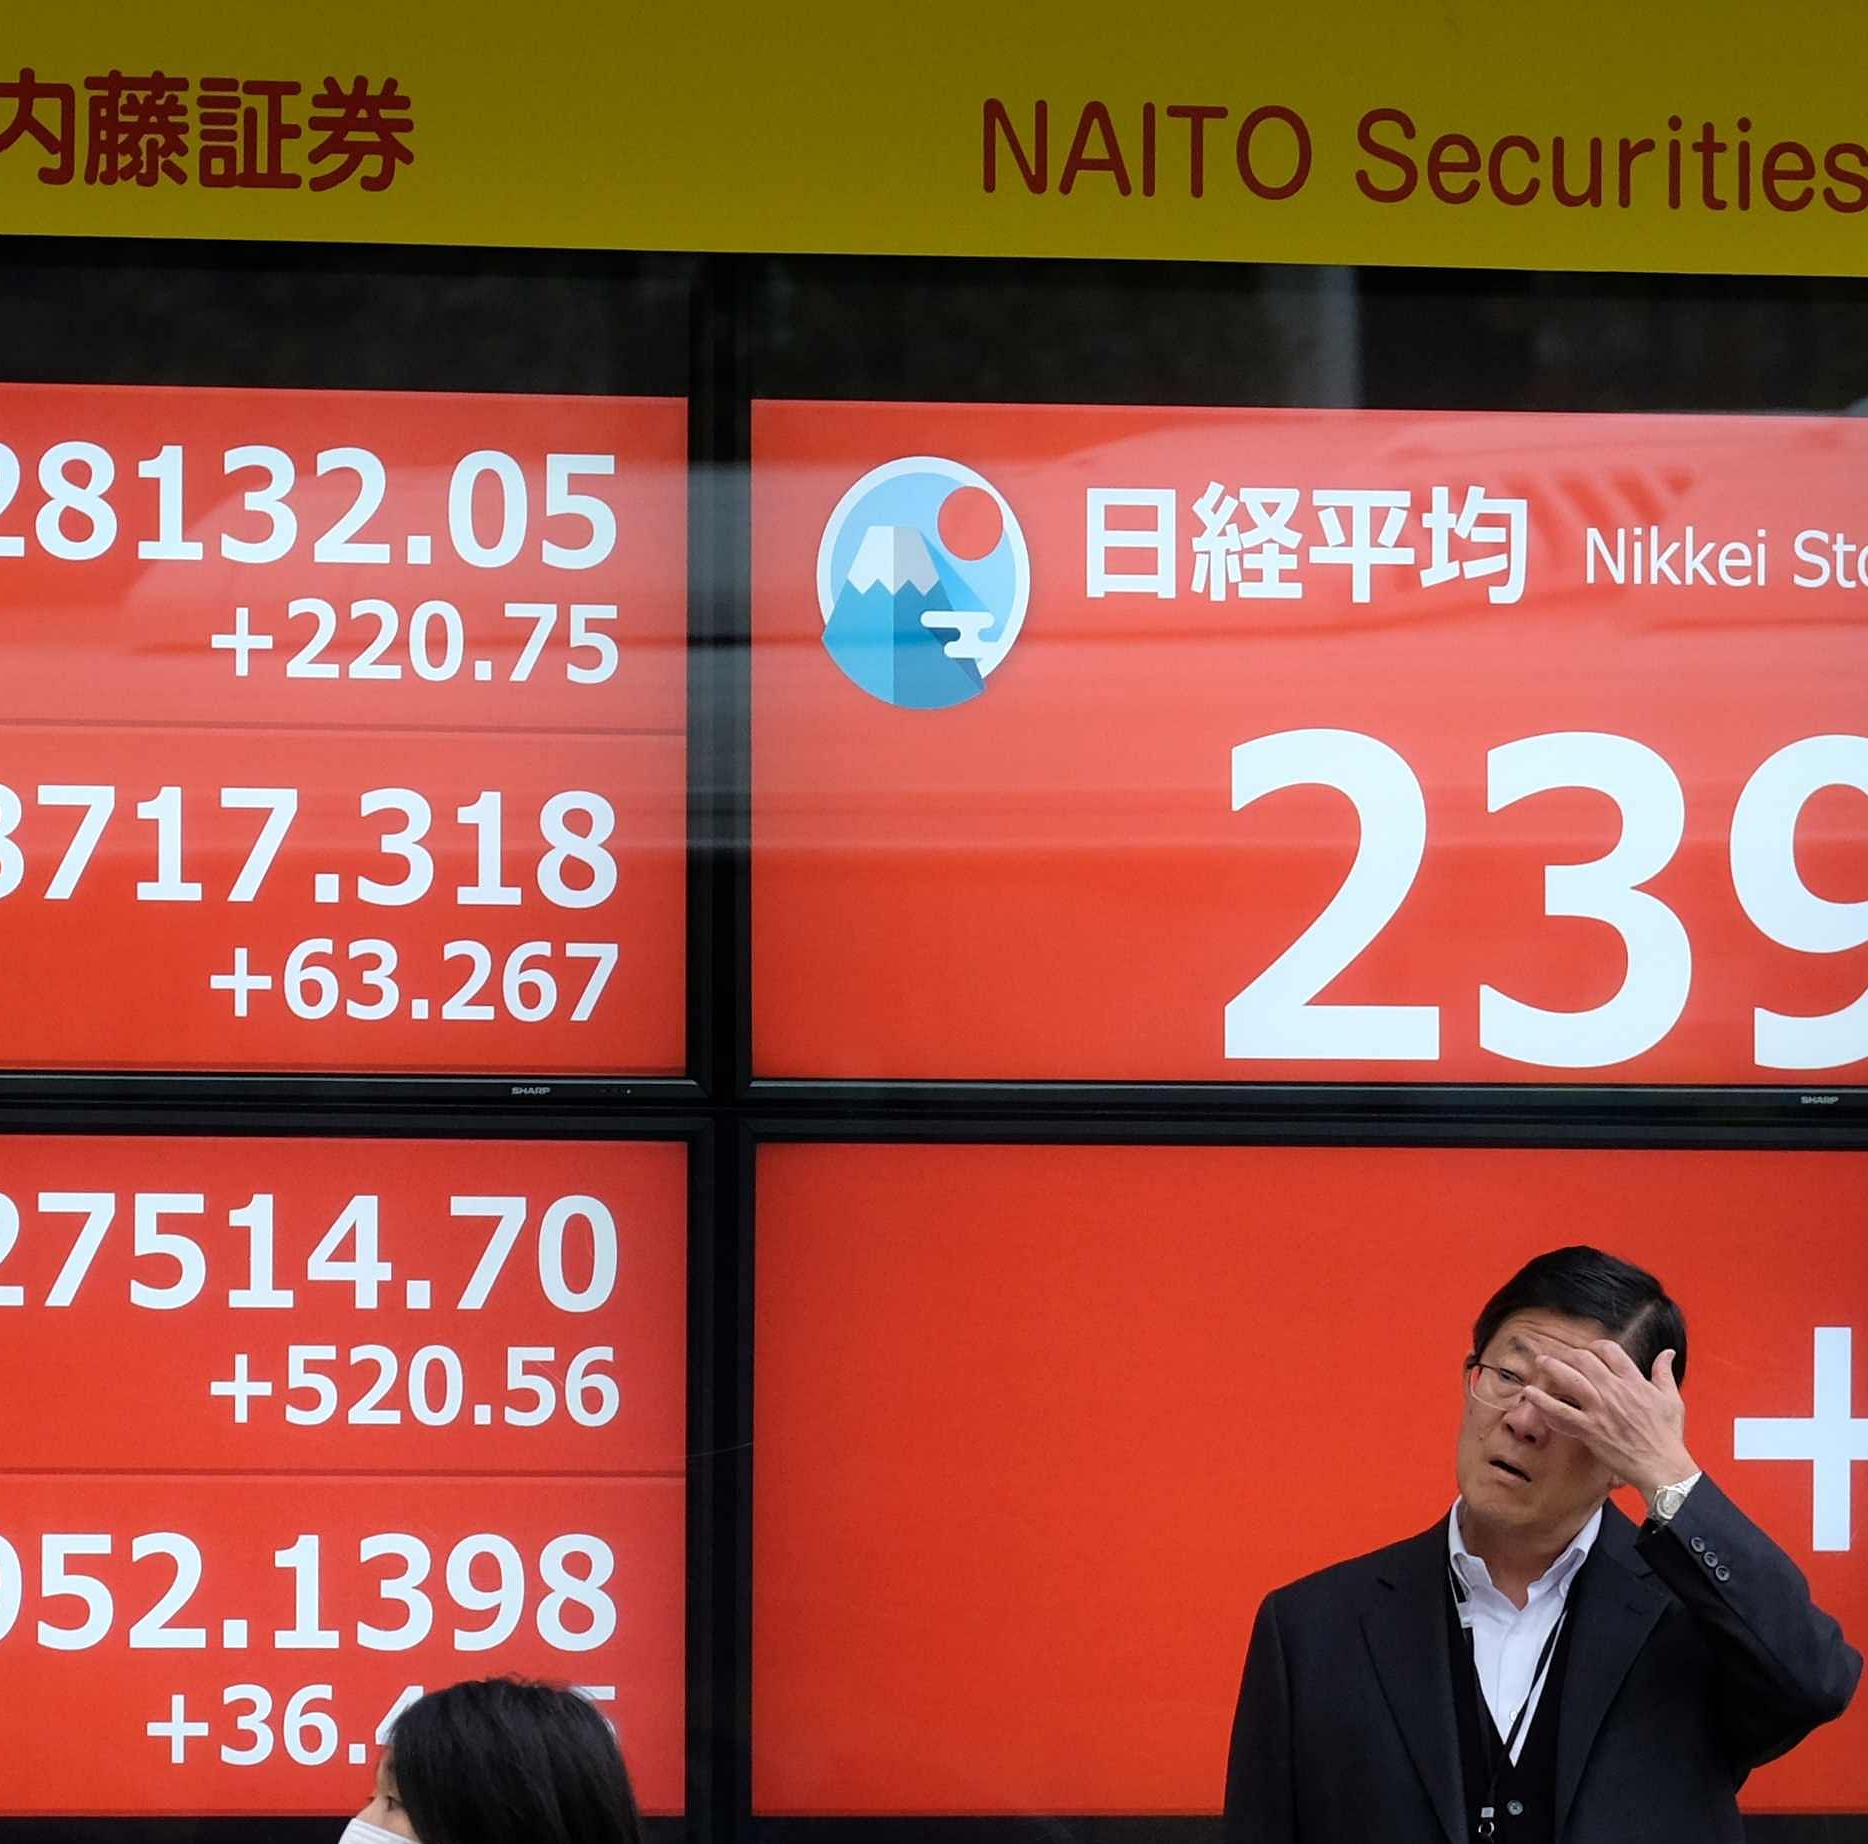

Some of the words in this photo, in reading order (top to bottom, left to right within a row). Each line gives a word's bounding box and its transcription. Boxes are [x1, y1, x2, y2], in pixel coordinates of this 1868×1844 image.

[983, 98, 1312, 200] NAITO
[1087, 481, 1527, 603] 日経平均
[1587, 526, 1765, 586] Nikkei
[212, 598, 618, 683] +220.75
[211, 938, 618, 1021] +63.267
[511, 1086, 551, 1095] SHARP
[1800, 1095, 1839, 1105] SHARP
[211, 1345, 619, 1426] +520.56
